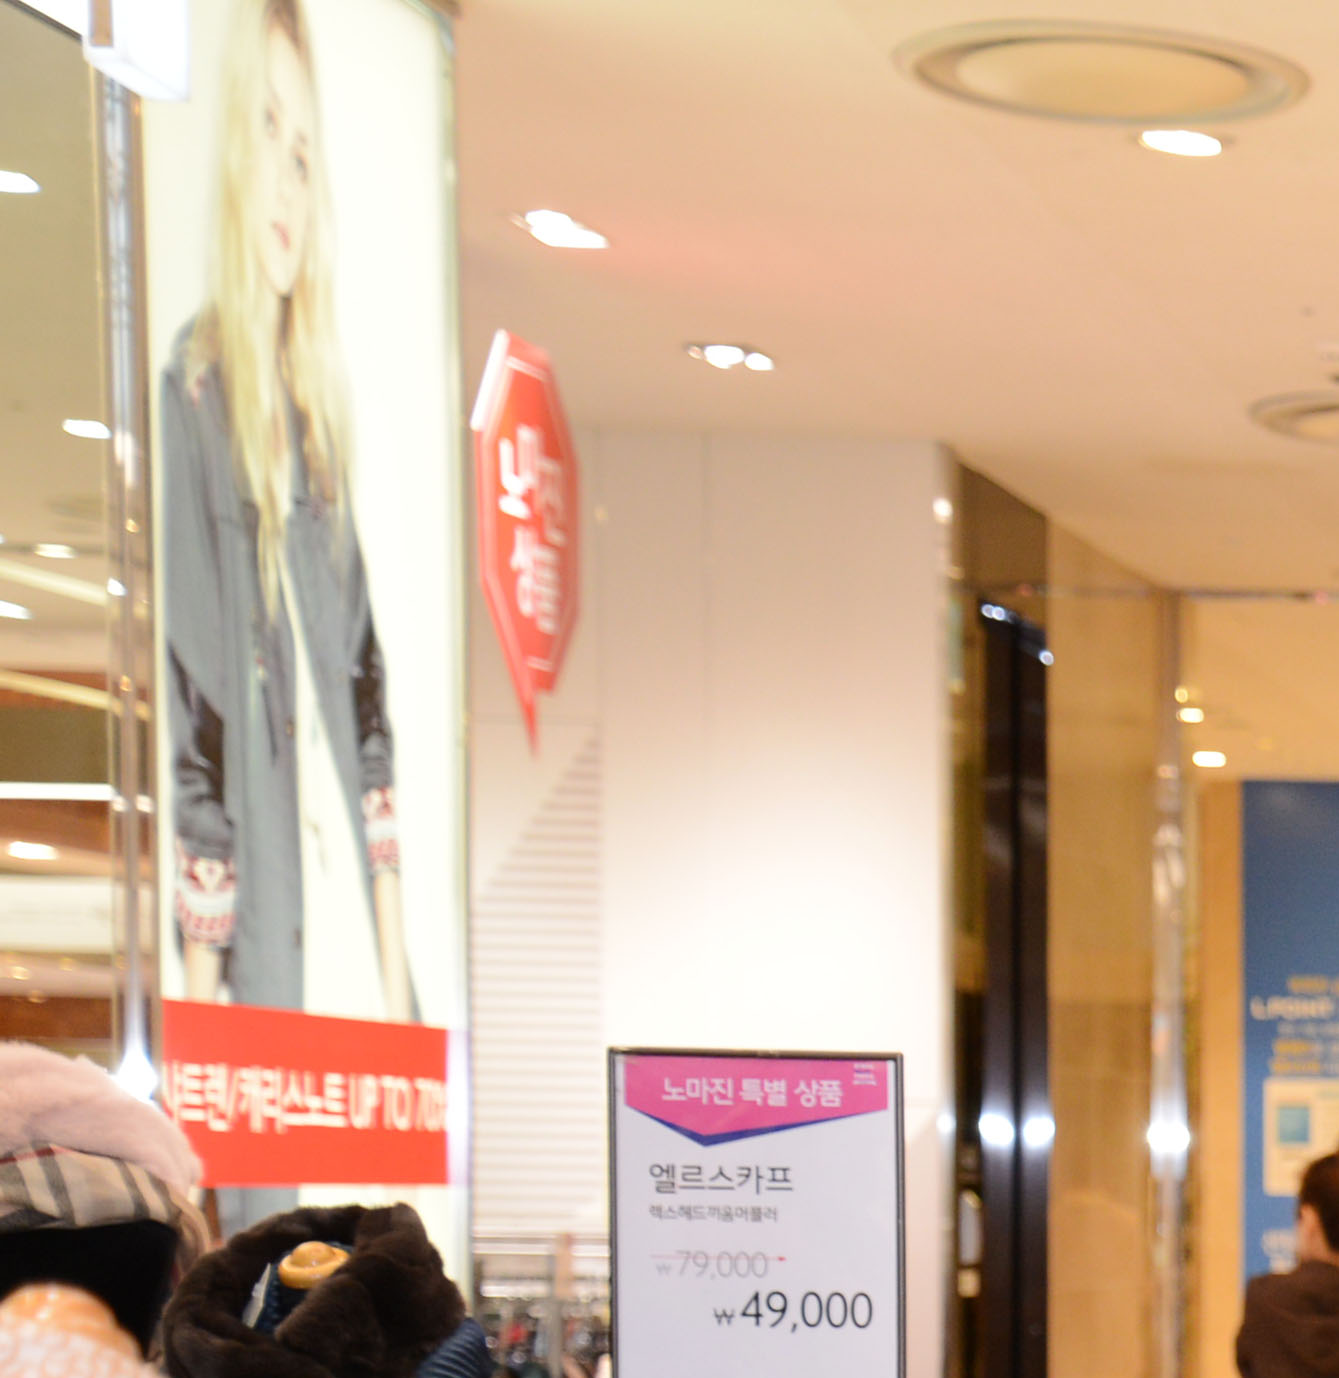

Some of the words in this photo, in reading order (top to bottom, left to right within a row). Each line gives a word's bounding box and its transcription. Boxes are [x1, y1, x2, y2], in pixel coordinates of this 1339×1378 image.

[349, 1072, 379, 1130] UP
[380, 1074, 412, 1132] TO
[413, 1077, 447, 1133] 70
[661, 1077, 734, 1105] 노마진
[739, 1077, 788, 1107] 특별
[794, 1079, 843, 1108] 상품
[648, 1163, 794, 1195] 엘르스카프
[713, 1290, 873, 1334] ₩49,000
